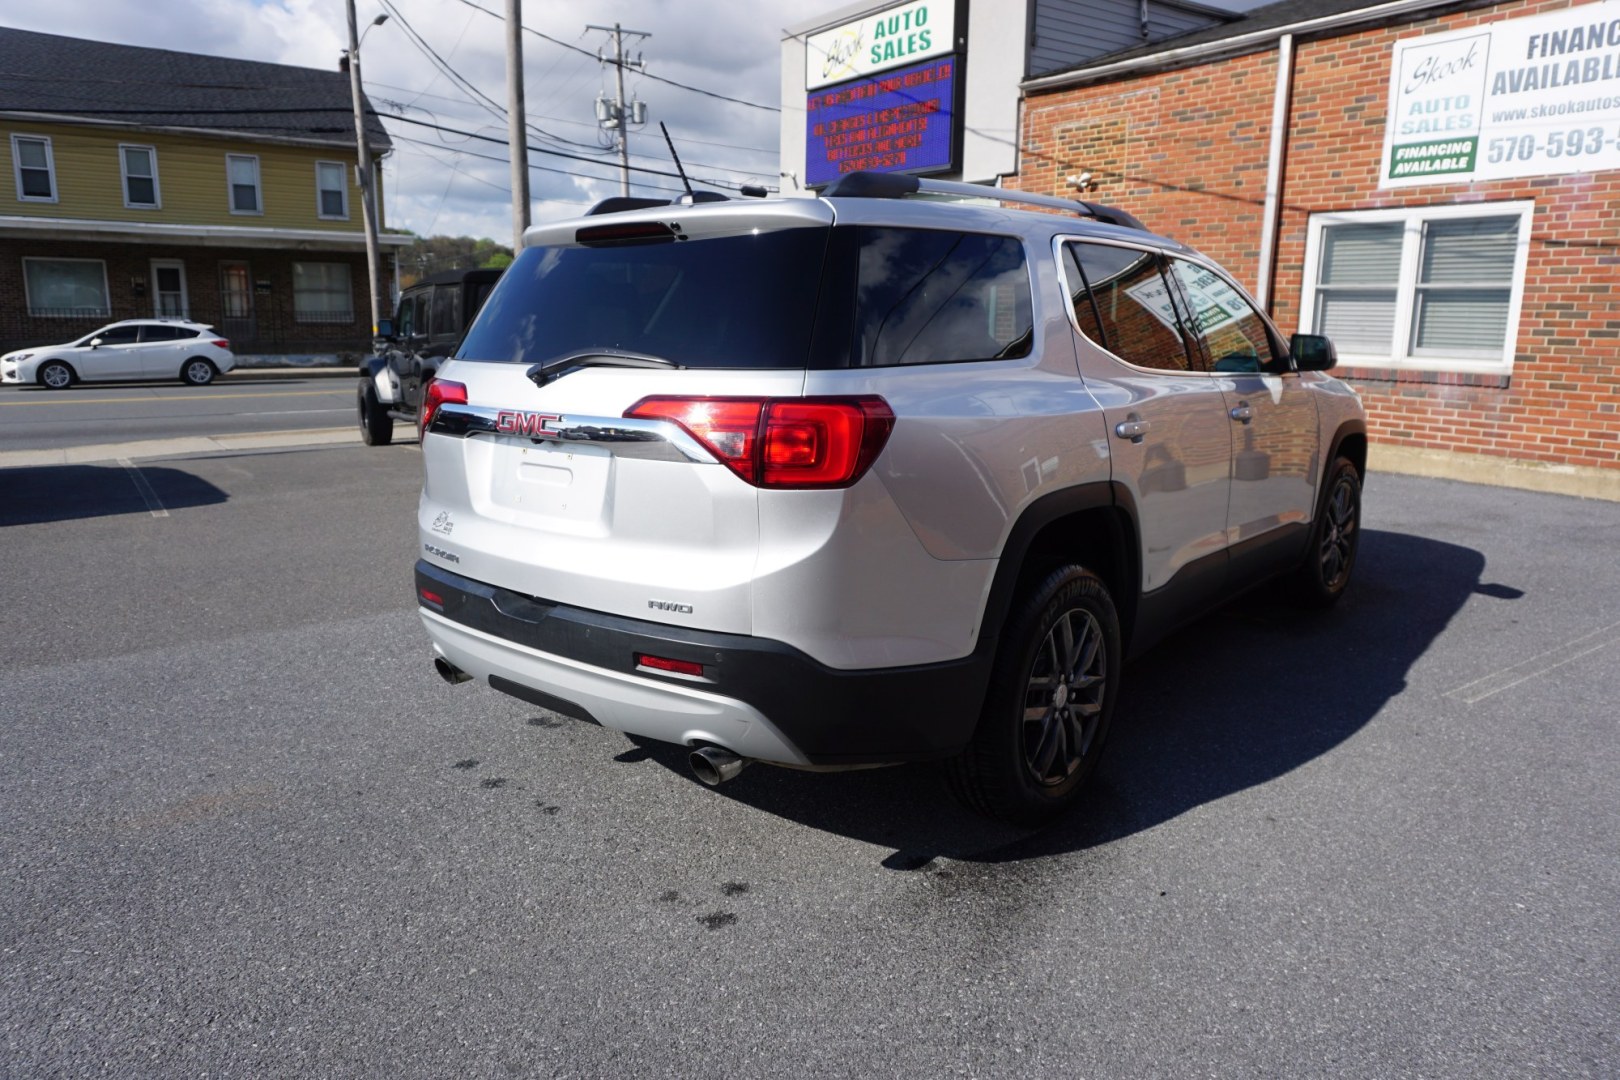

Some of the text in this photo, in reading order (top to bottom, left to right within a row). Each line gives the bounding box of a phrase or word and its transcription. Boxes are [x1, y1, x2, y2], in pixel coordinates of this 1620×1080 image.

[874, 6, 928, 40] AUTO
[870, 29, 932, 65] SALES
[1527, 18, 1620, 59] FINANC
[1404, 40, 1478, 94] Skook
[1408, 94, 1471, 116] AUTO
[1401, 113, 1473, 135] SALES
[1395, 141, 1472, 160] FINANCING
[1487, 124, 1620, 164] 570-593-
[1393, 157, 1469, 175] AVAILABLE
[496, 411, 562, 437] GMC
[648, 600, 693, 614] AWD
